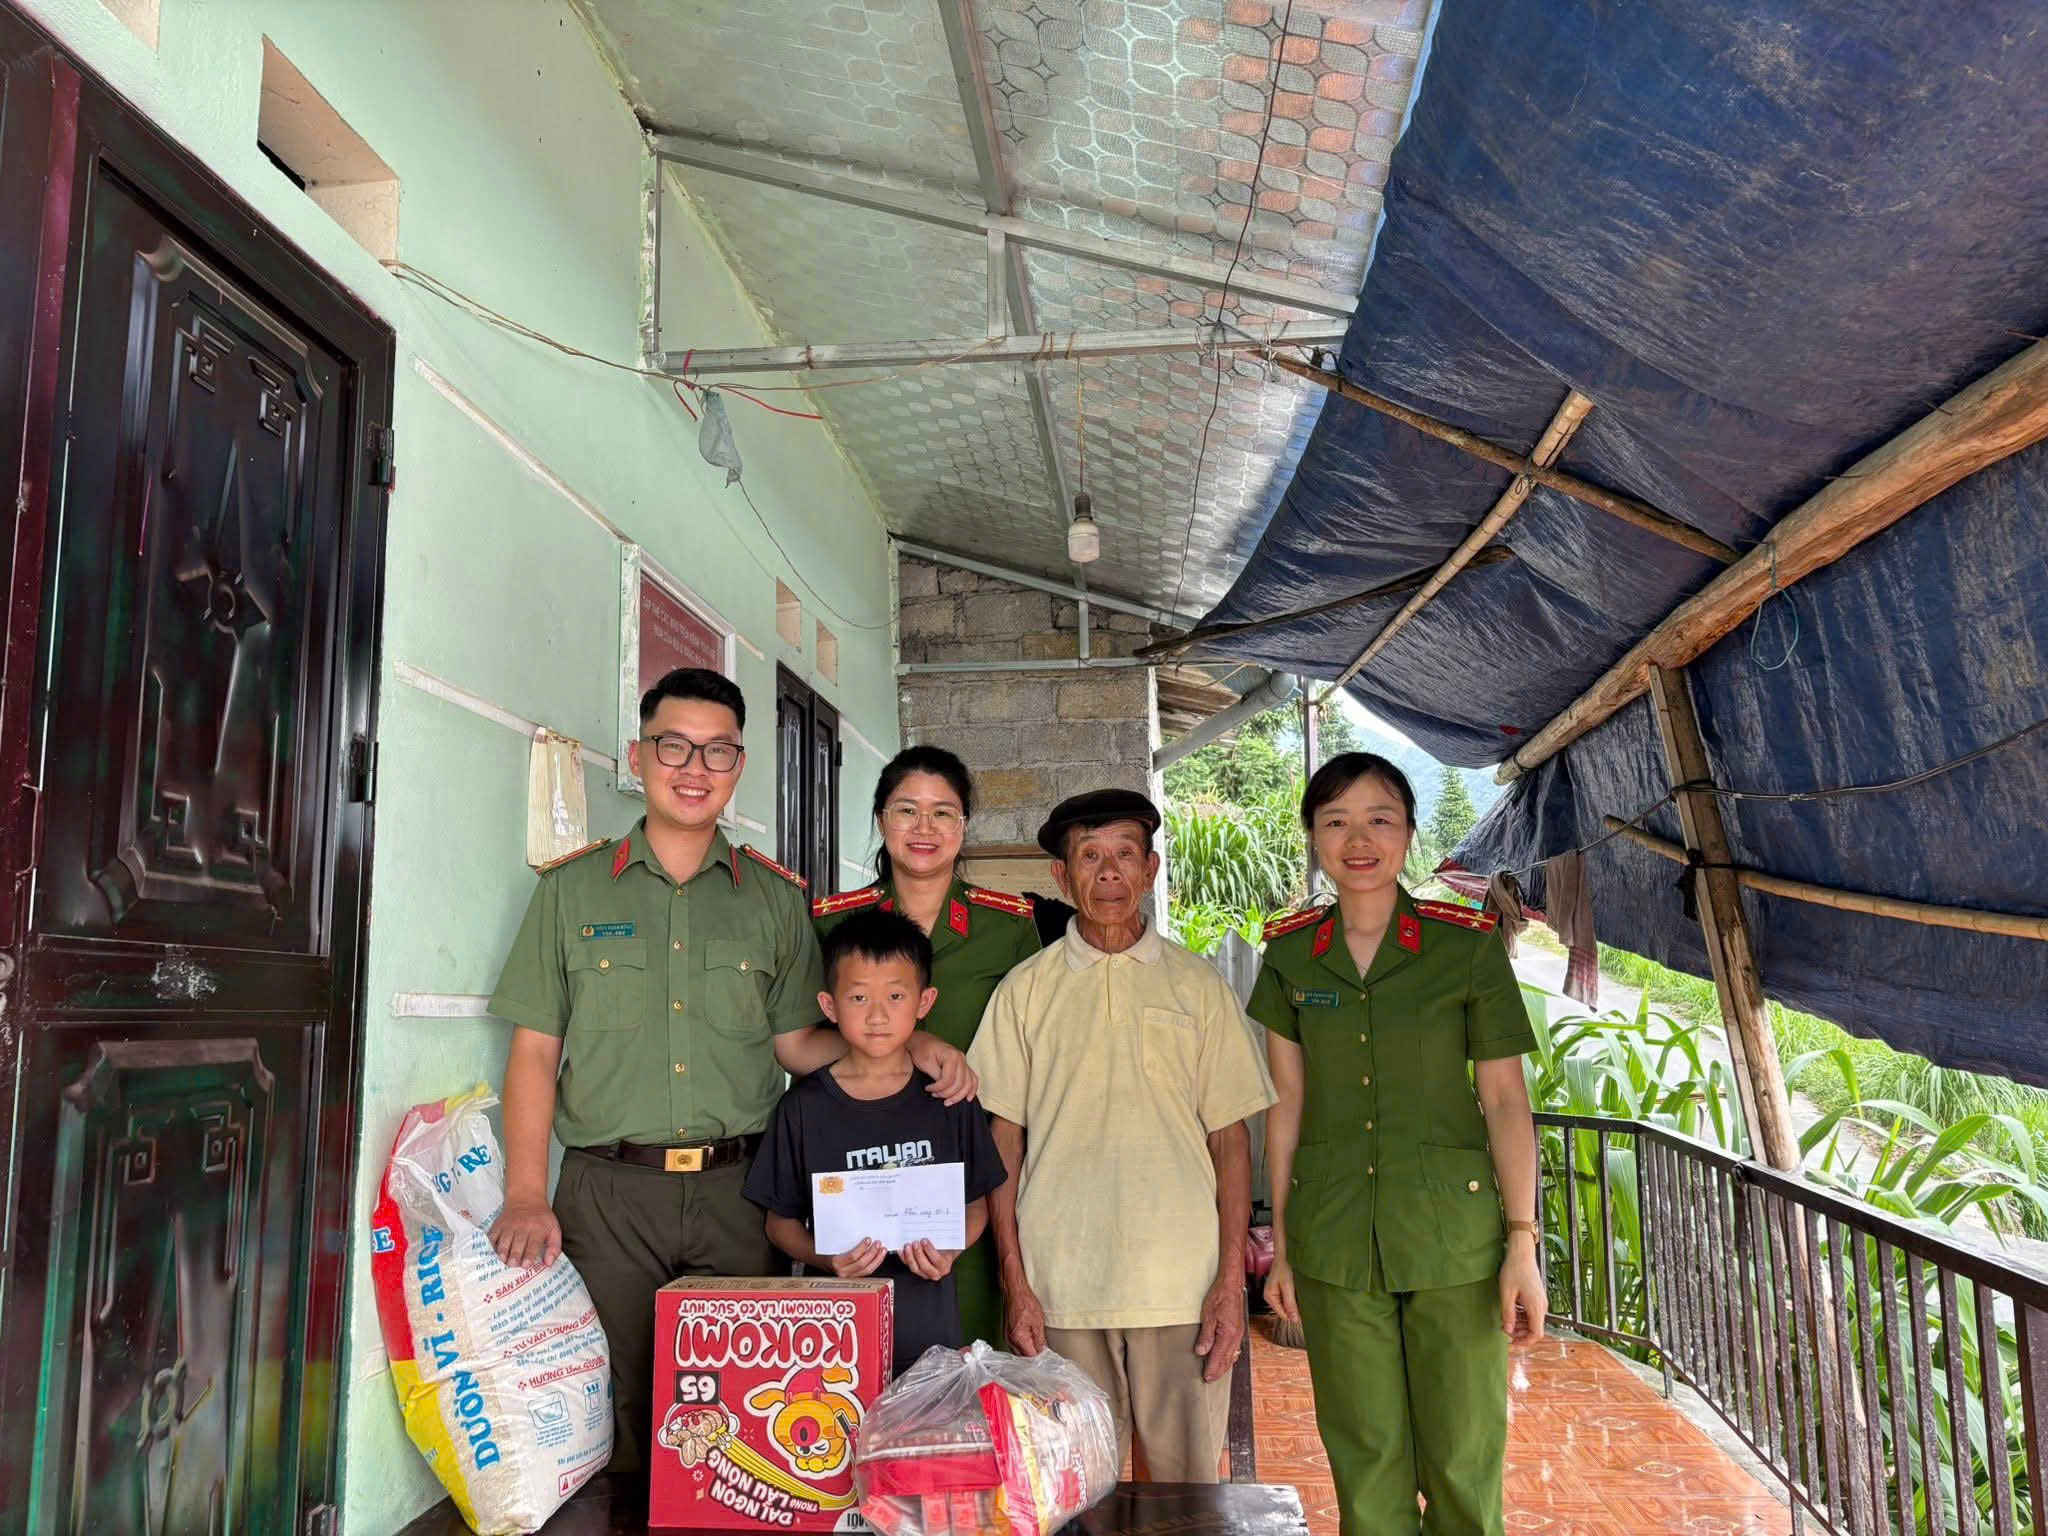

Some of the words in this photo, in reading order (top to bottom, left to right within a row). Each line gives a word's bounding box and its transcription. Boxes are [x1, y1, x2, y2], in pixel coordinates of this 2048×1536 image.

[781, 1301, 831, 1316] KOKOMI
[677, 1320, 856, 1365] KOKOMI
[680, 1375, 716, 1401] 65
